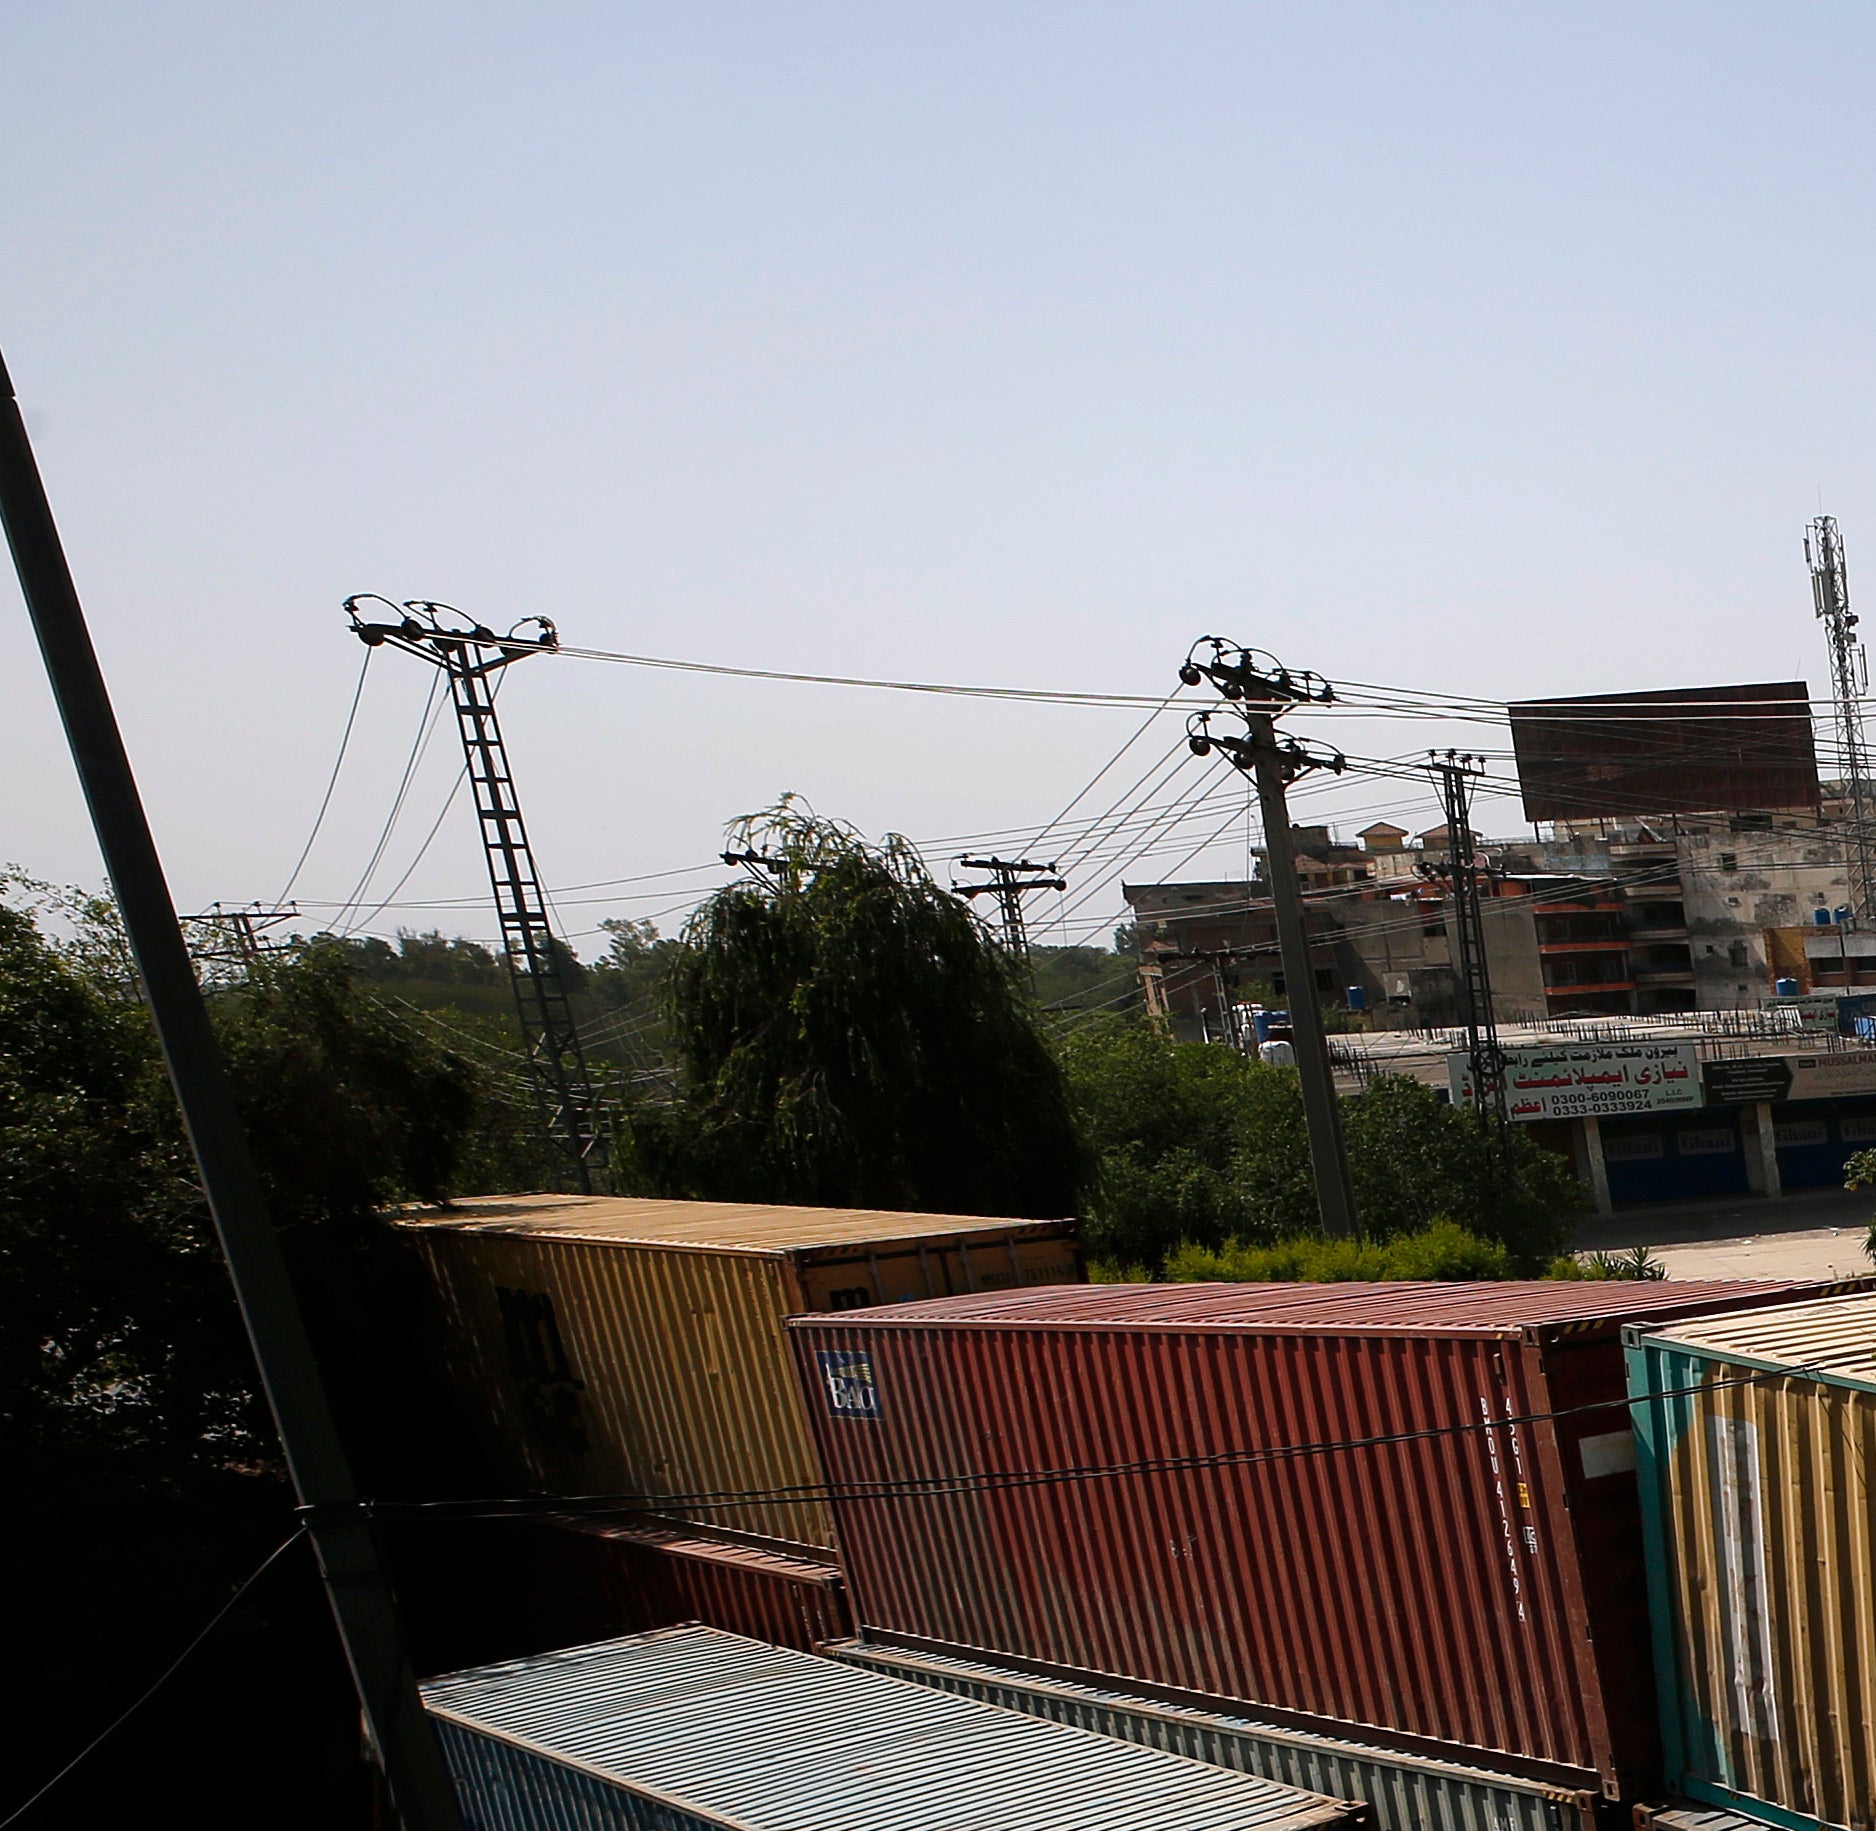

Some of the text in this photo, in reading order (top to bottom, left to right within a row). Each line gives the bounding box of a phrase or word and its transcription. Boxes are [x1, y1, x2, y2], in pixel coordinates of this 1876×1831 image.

[1634, 1060, 1689, 1085] نیازی
[1551, 1089, 1651, 1106] 0300-6090067
[1552, 1100, 1653, 1117] 0333-0333924
